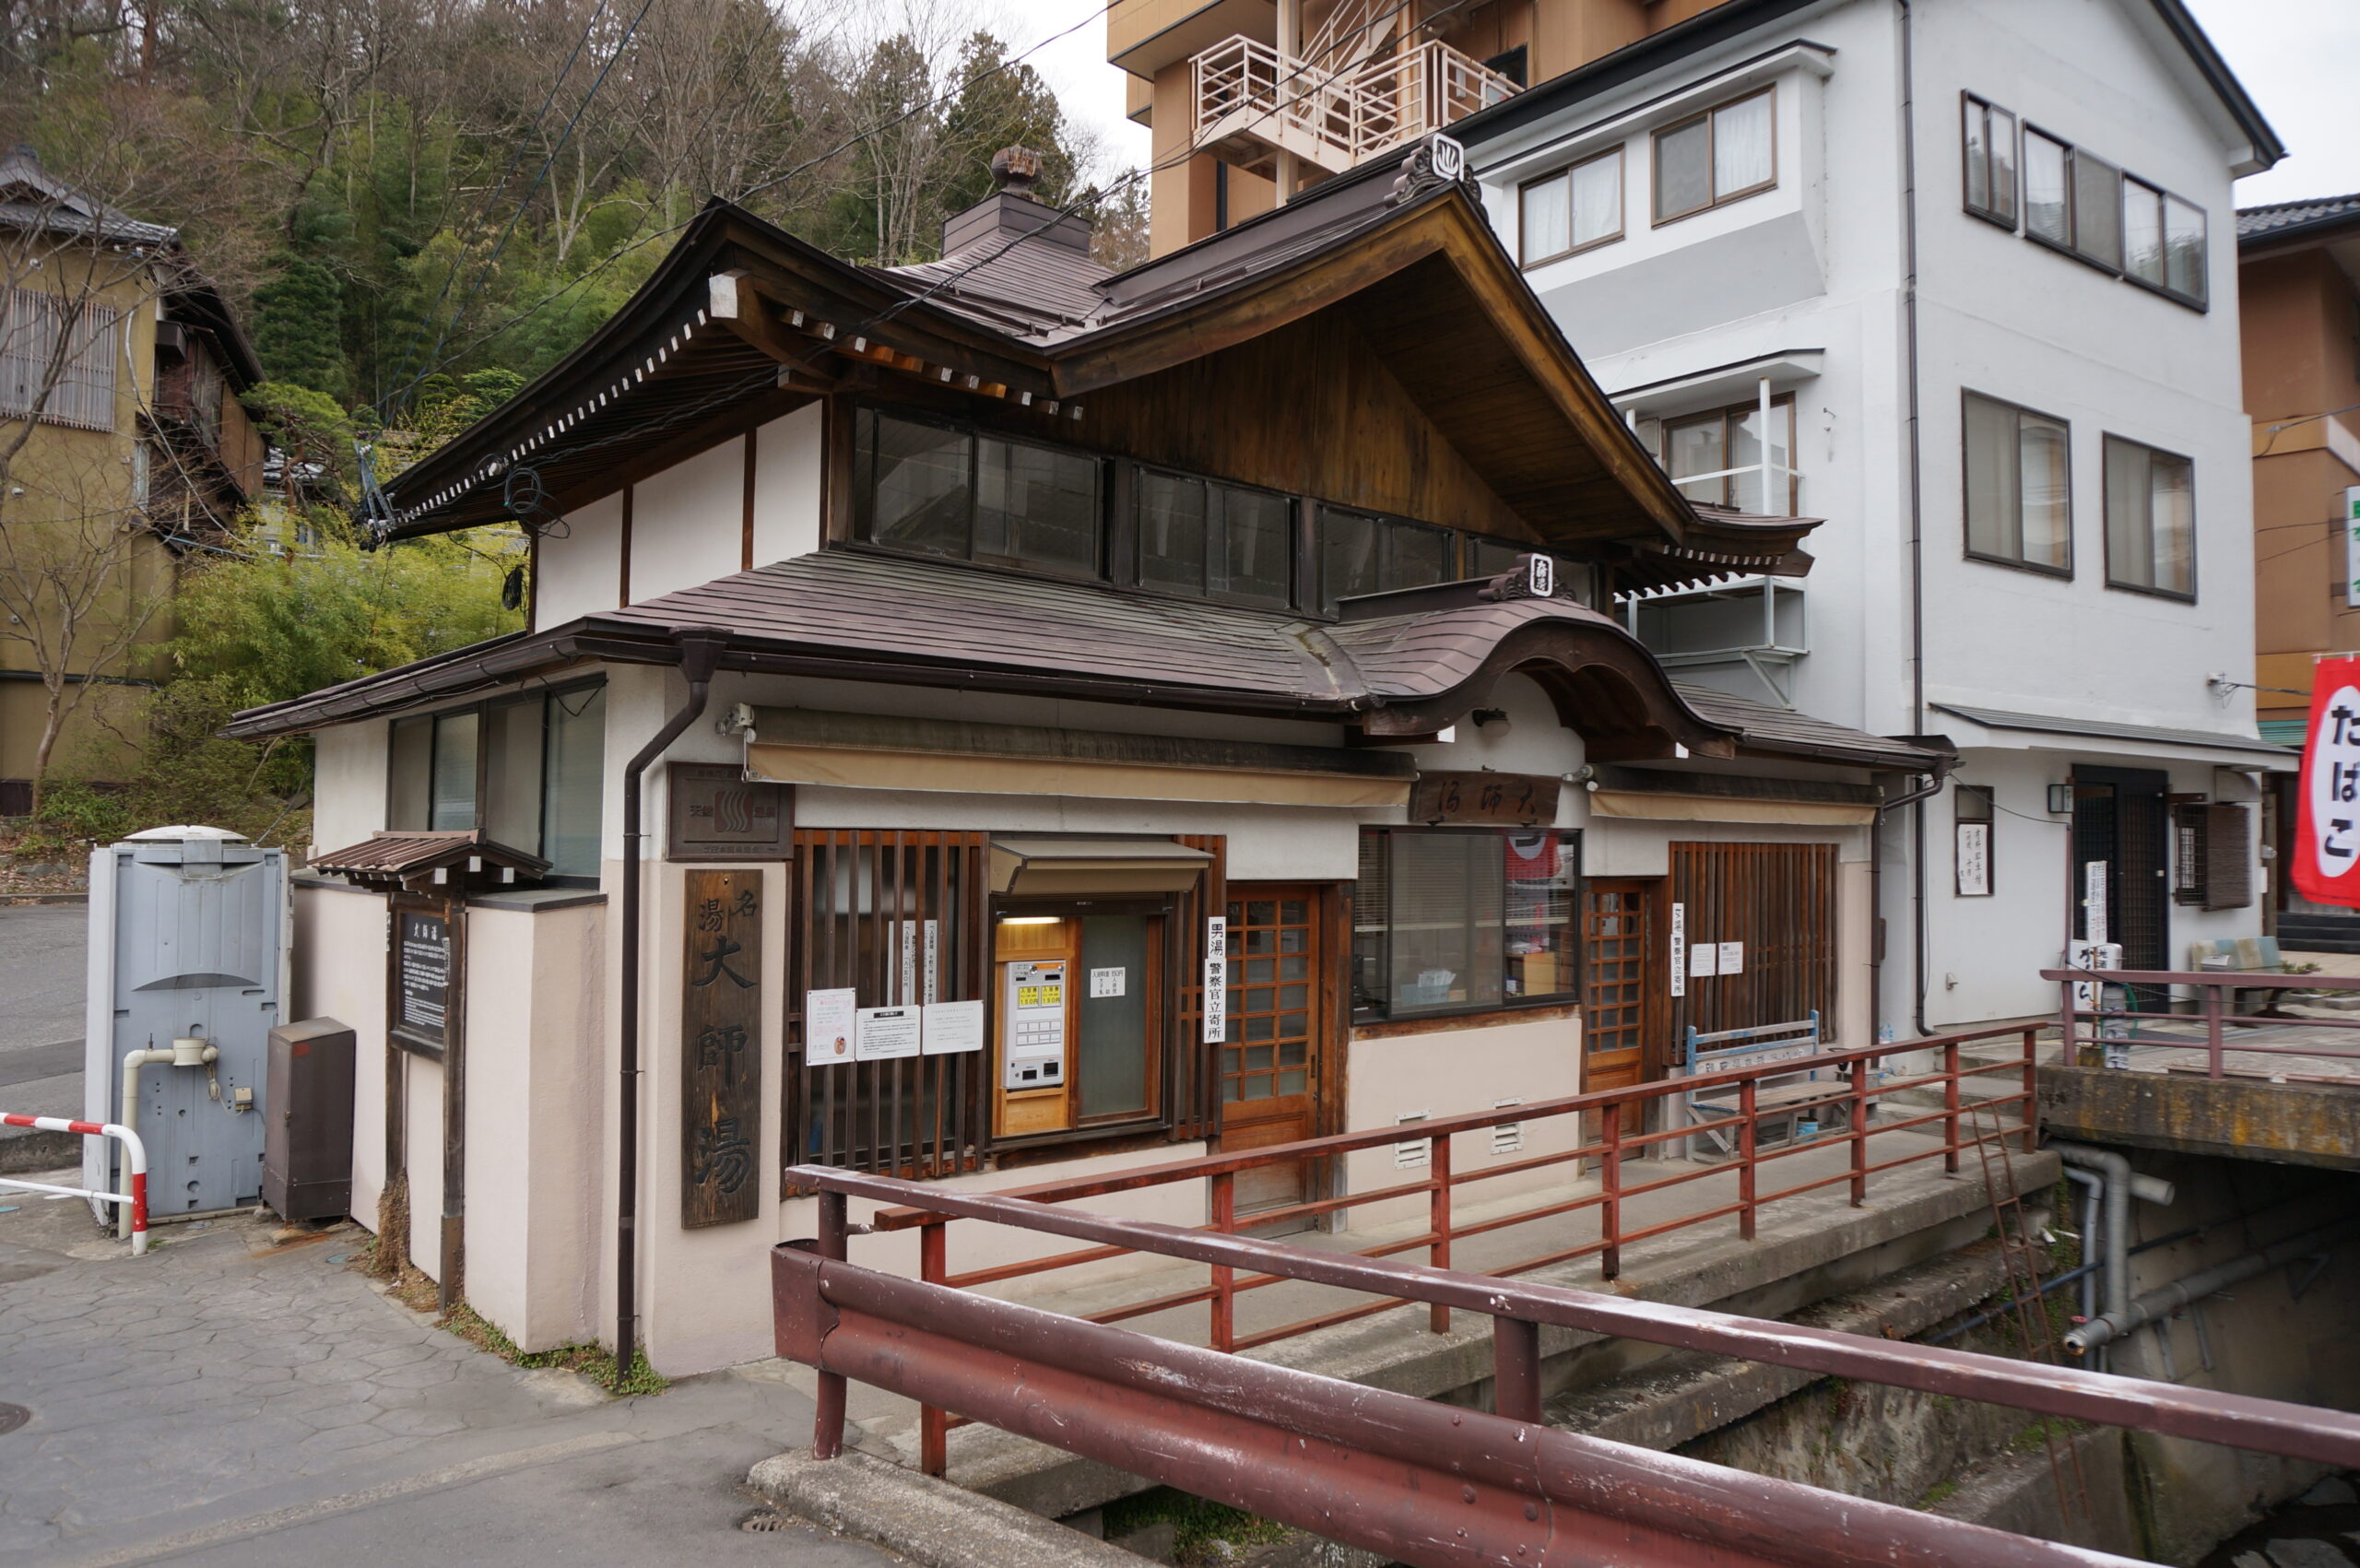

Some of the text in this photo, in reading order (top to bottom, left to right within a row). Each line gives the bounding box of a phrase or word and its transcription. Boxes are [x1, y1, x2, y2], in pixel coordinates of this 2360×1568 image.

[1210, 923, 1223, 956] 男湯
[1673, 937, 1682, 994] 警察官立寄所
[1208, 962, 1222, 1040] 警察官立寄所
[691, 935, 759, 1194] 大師湯
